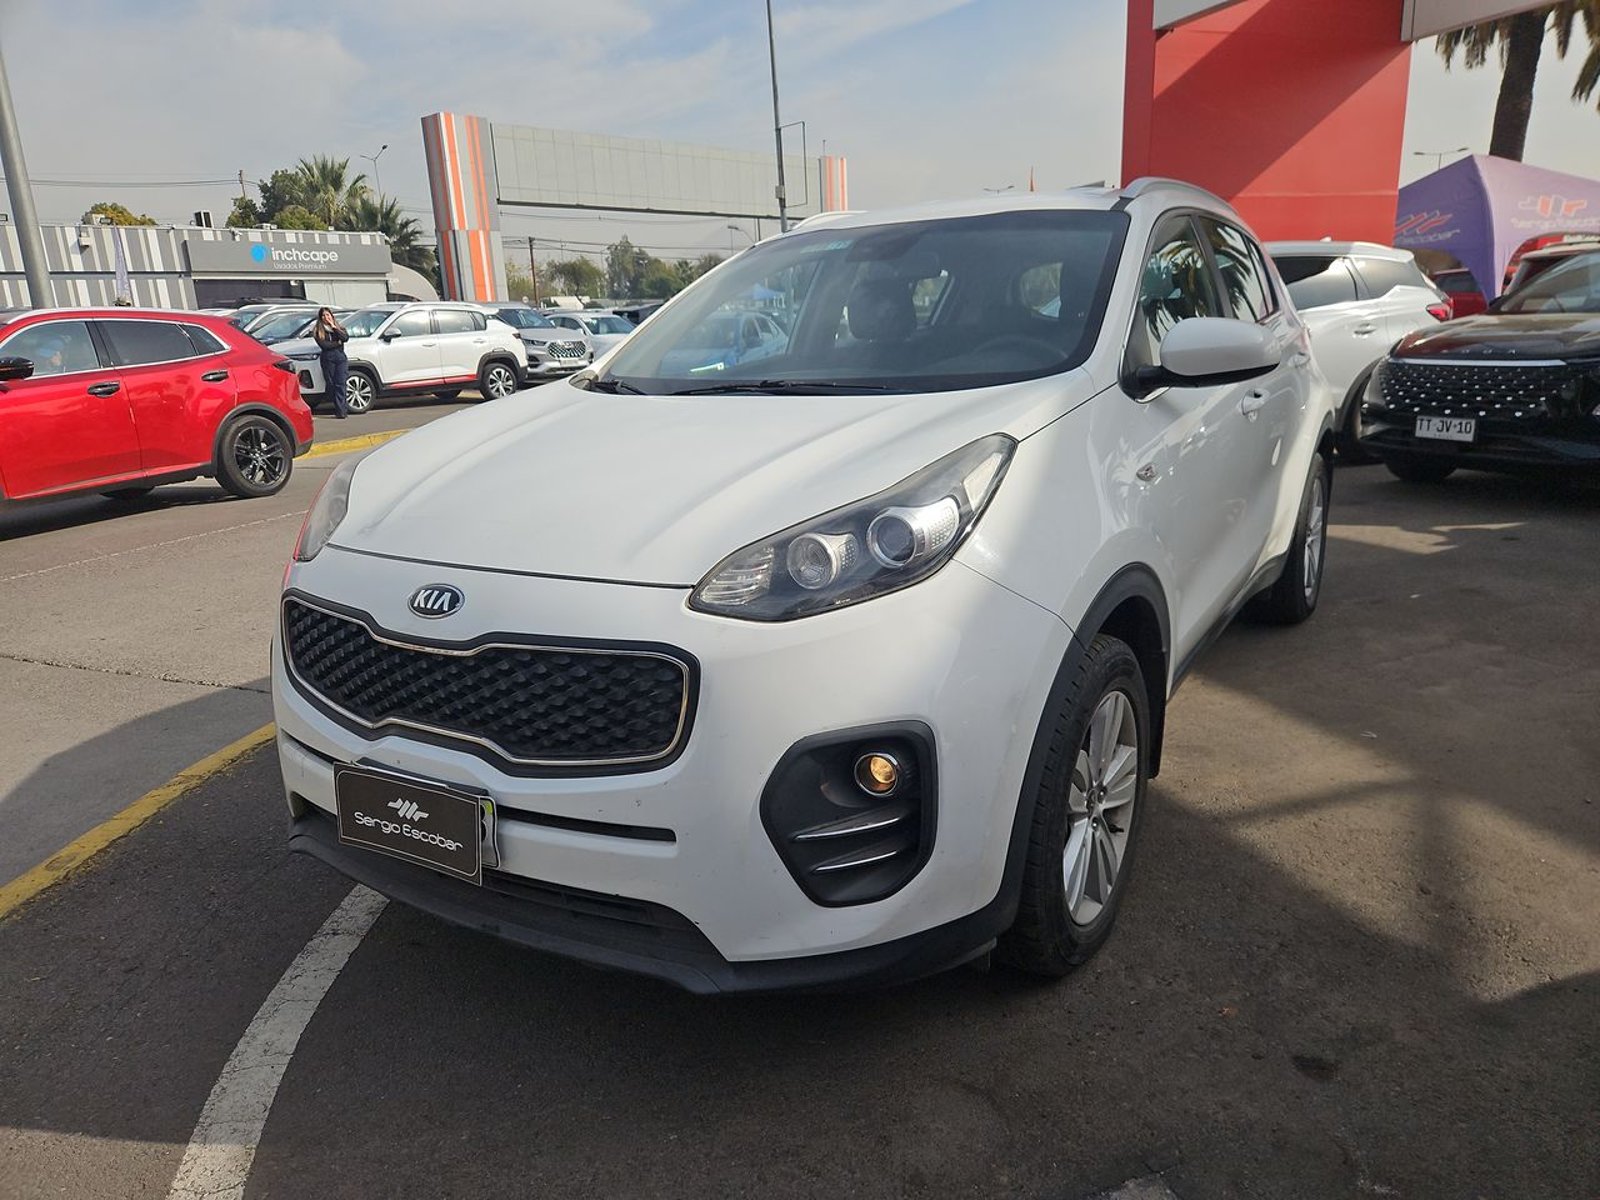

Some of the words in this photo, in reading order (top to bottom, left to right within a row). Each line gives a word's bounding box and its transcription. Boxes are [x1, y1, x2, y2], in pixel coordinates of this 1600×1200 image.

[271, 247, 338, 264] inchcape
[274, 262, 297, 270] Usados
[413, 589, 451, 611] KIA
[354, 811, 401, 834] Sergo
[402, 823, 463, 851] Escobar
